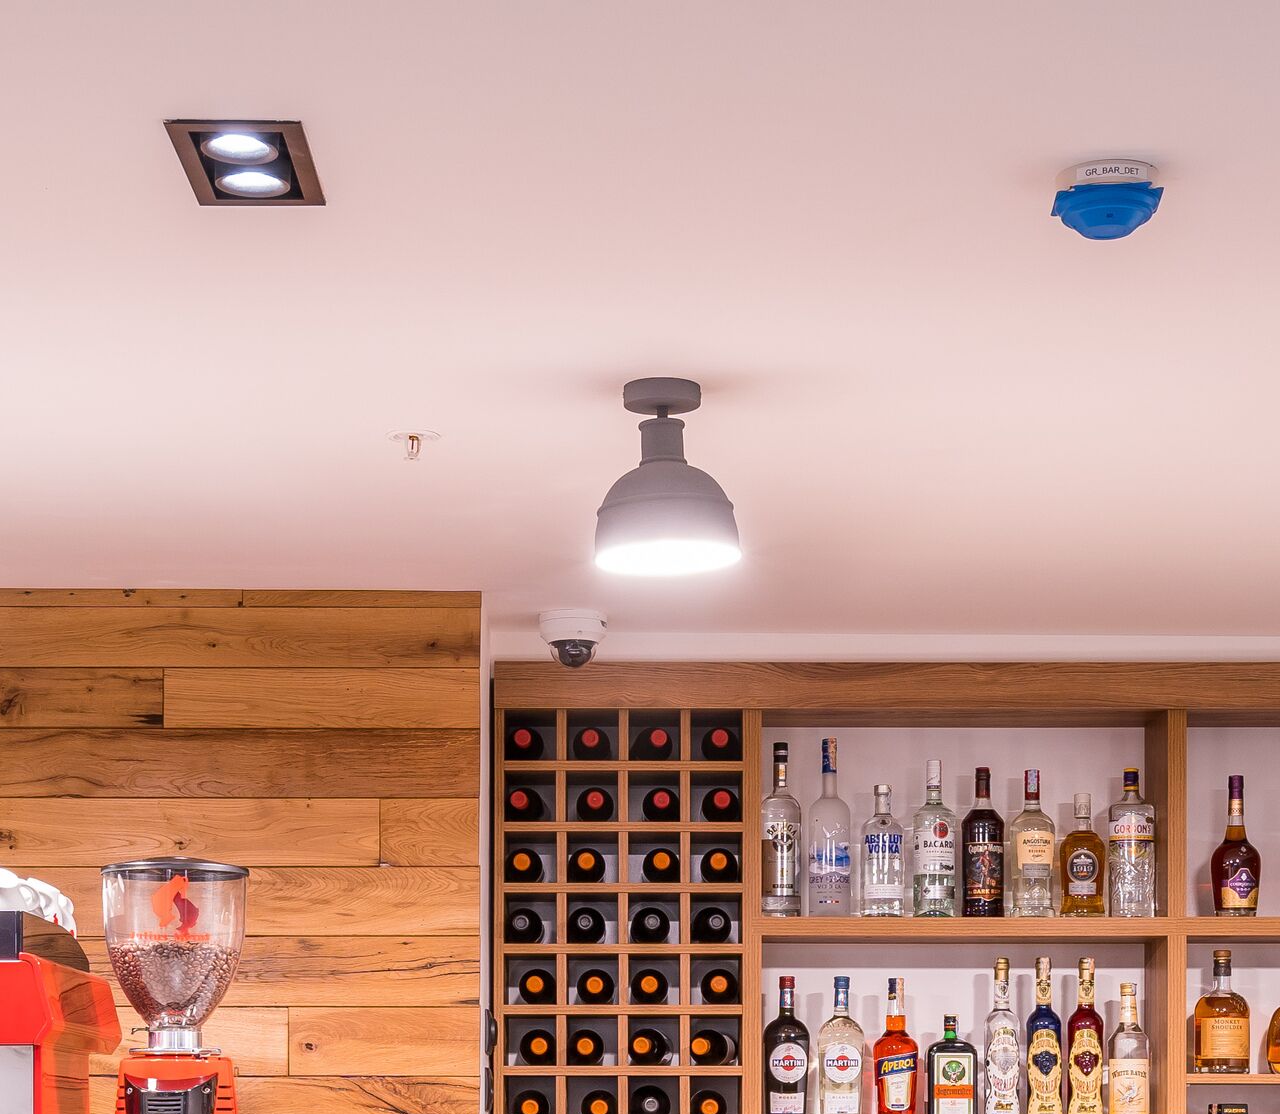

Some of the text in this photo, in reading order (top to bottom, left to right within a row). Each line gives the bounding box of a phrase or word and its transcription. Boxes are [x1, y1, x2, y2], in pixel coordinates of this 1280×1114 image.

[1085, 166, 1140, 177] GR_BAR_DET
[766, 823, 798, 836] BEGA
[864, 834, 903, 844] ABSOLUT
[868, 844, 900, 853] VODKA
[773, 1059, 804, 1067] MARTINI
[827, 1059, 858, 1067] MARTINI
[881, 1058, 914, 1074] APEROL
